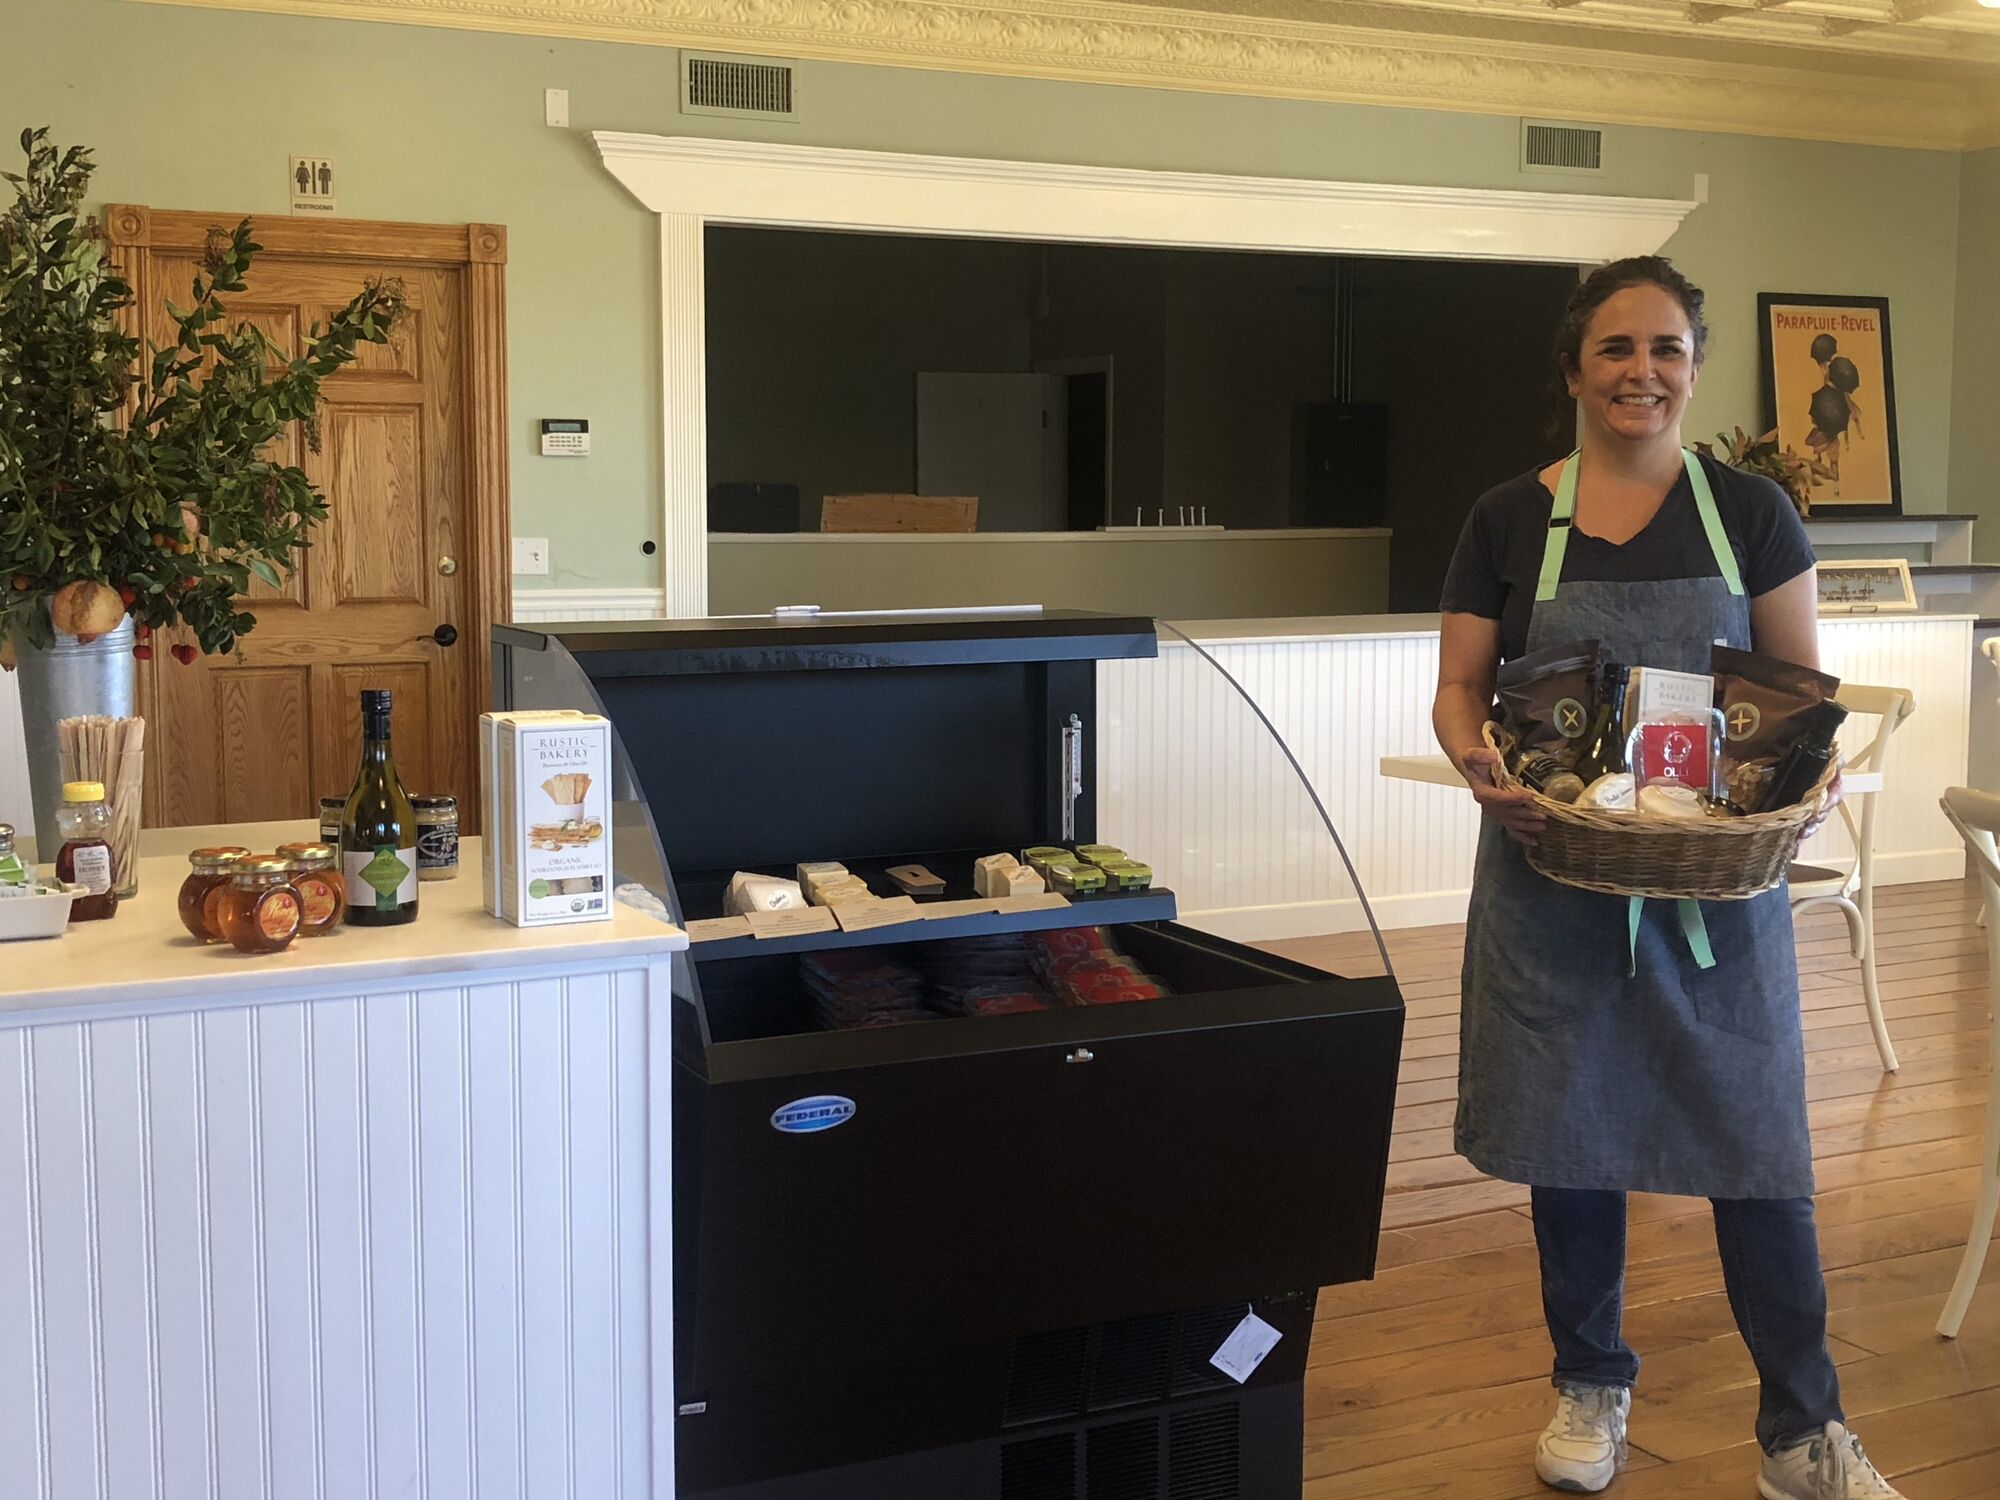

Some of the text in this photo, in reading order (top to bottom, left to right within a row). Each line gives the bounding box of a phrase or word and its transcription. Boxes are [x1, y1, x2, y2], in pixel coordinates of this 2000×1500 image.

[540, 737, 588, 747] RUSTIC
[540, 749, 588, 759] BAKERY
[775, 1104, 853, 1123] FEDERAL
